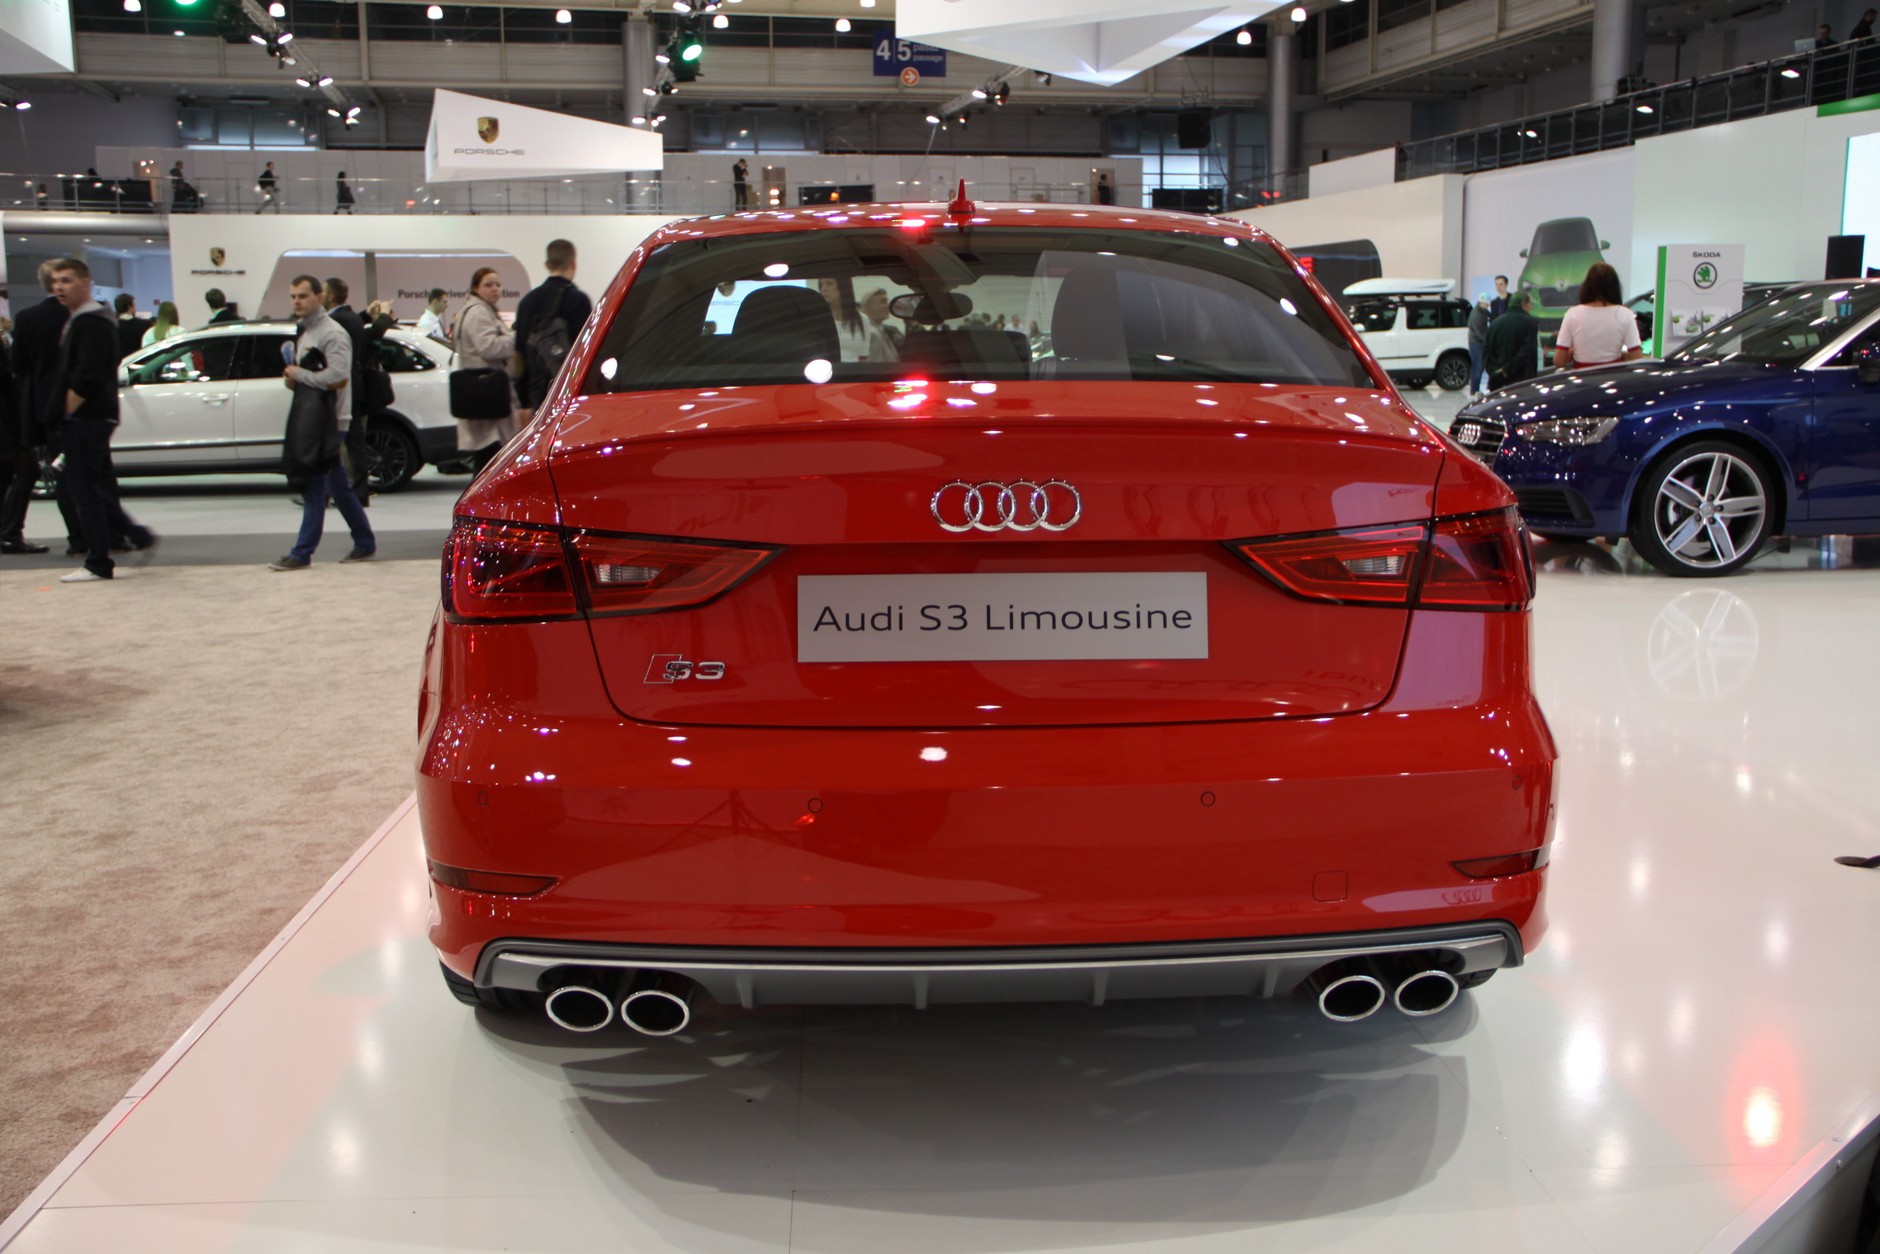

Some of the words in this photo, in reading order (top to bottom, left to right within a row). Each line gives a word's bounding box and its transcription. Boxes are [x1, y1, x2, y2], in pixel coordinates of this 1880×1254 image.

[876, 39, 892, 61] 4
[897, 40, 912, 62] 5
[913, 54, 943, 63] passage
[398, 289, 429, 299] Porsch
[813, 605, 904, 632] Audi
[919, 604, 969, 631] S3
[985, 603, 1193, 631] Limousine
[662, 661, 726, 680] S3
